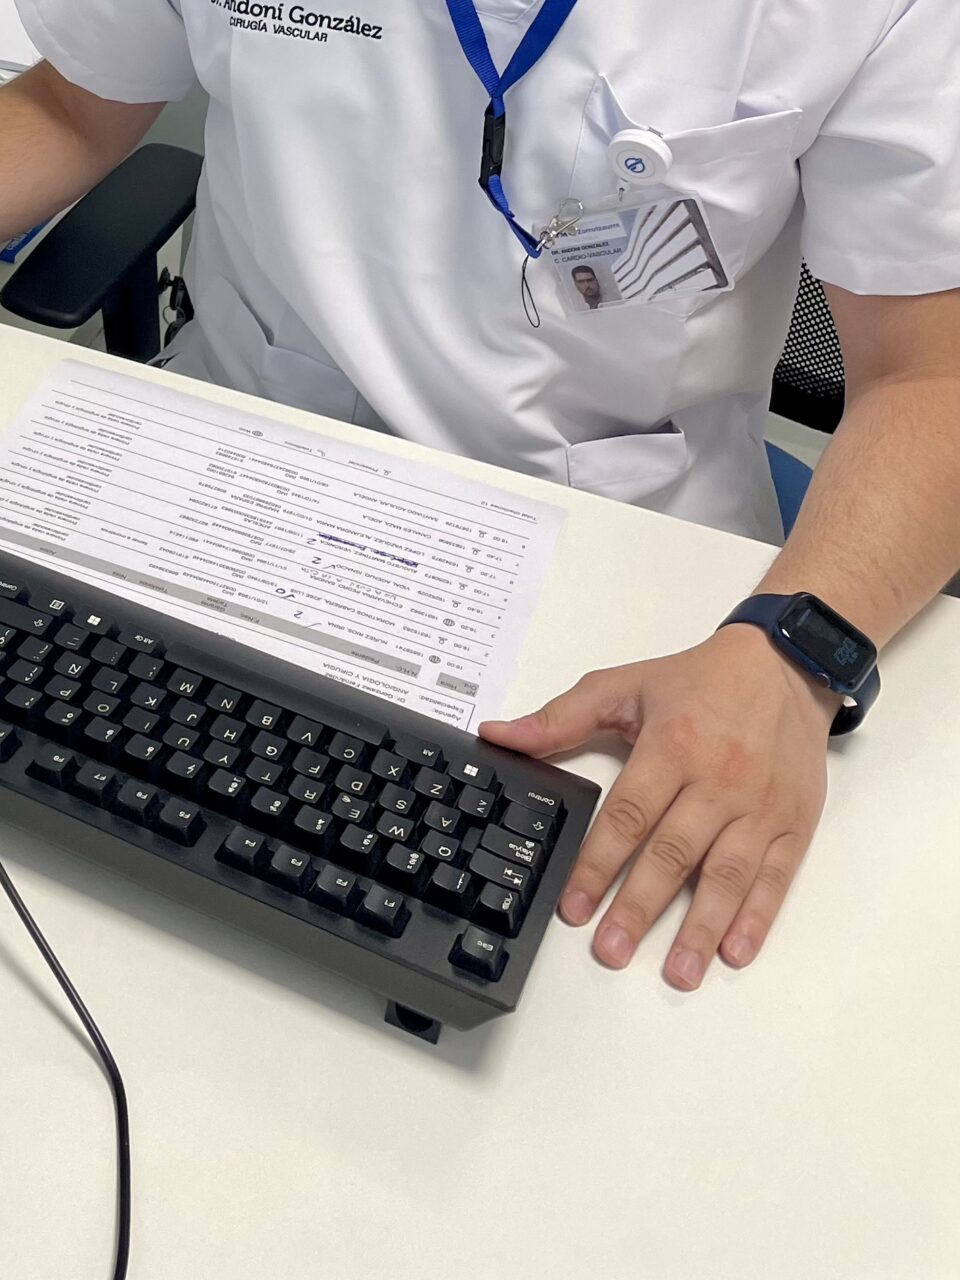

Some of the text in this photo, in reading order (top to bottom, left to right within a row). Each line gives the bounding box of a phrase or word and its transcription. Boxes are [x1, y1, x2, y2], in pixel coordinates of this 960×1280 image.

[288, 5, 383, 40] González
[229, 16, 328, 42] CIRUGÍA VASCULAR
[309, 555, 322, 565] 2
[291, 609, 304, 620] 2
[67, 663, 82, 675] Ñ
[179, 682, 194, 693] M
[59, 689, 72, 697] P
[144, 696, 157, 706] K
[220, 698, 233, 709] N
[97, 703, 110, 712] O
[186, 713, 197, 722] J
[261, 715, 273, 726] B
[223, 729, 237, 740] H
[300, 732, 312, 742] V
[177, 737, 190, 747] U
[265, 745, 278, 756] G
[343, 748, 355, 759] C
[422, 748, 434, 757] Alt
[53, 755, 65, 763] F8
[218, 755, 228, 764] Y
[308, 765, 321, 774] F
[387, 765, 400, 776] X
[93, 773, 107, 781] F7
[260, 772, 271, 781] T
[351, 781, 363, 791] D
[430, 783, 443, 795] Z
[136, 791, 148, 800] F6
[304, 789, 317, 800] R
[527, 791, 555, 806] Control
[395, 799, 407, 810] S
[178, 810, 191, 819] F5
[348, 808, 361, 819] E
[441, 816, 453, 827] A
[388, 825, 404, 837] W
[244, 839, 257, 847] F4
[438, 845, 452, 857] Q
[290, 858, 303, 867] F3
[335, 878, 348, 887] F2
[384, 899, 396, 908] F1
[476, 940, 494, 951] Esc
